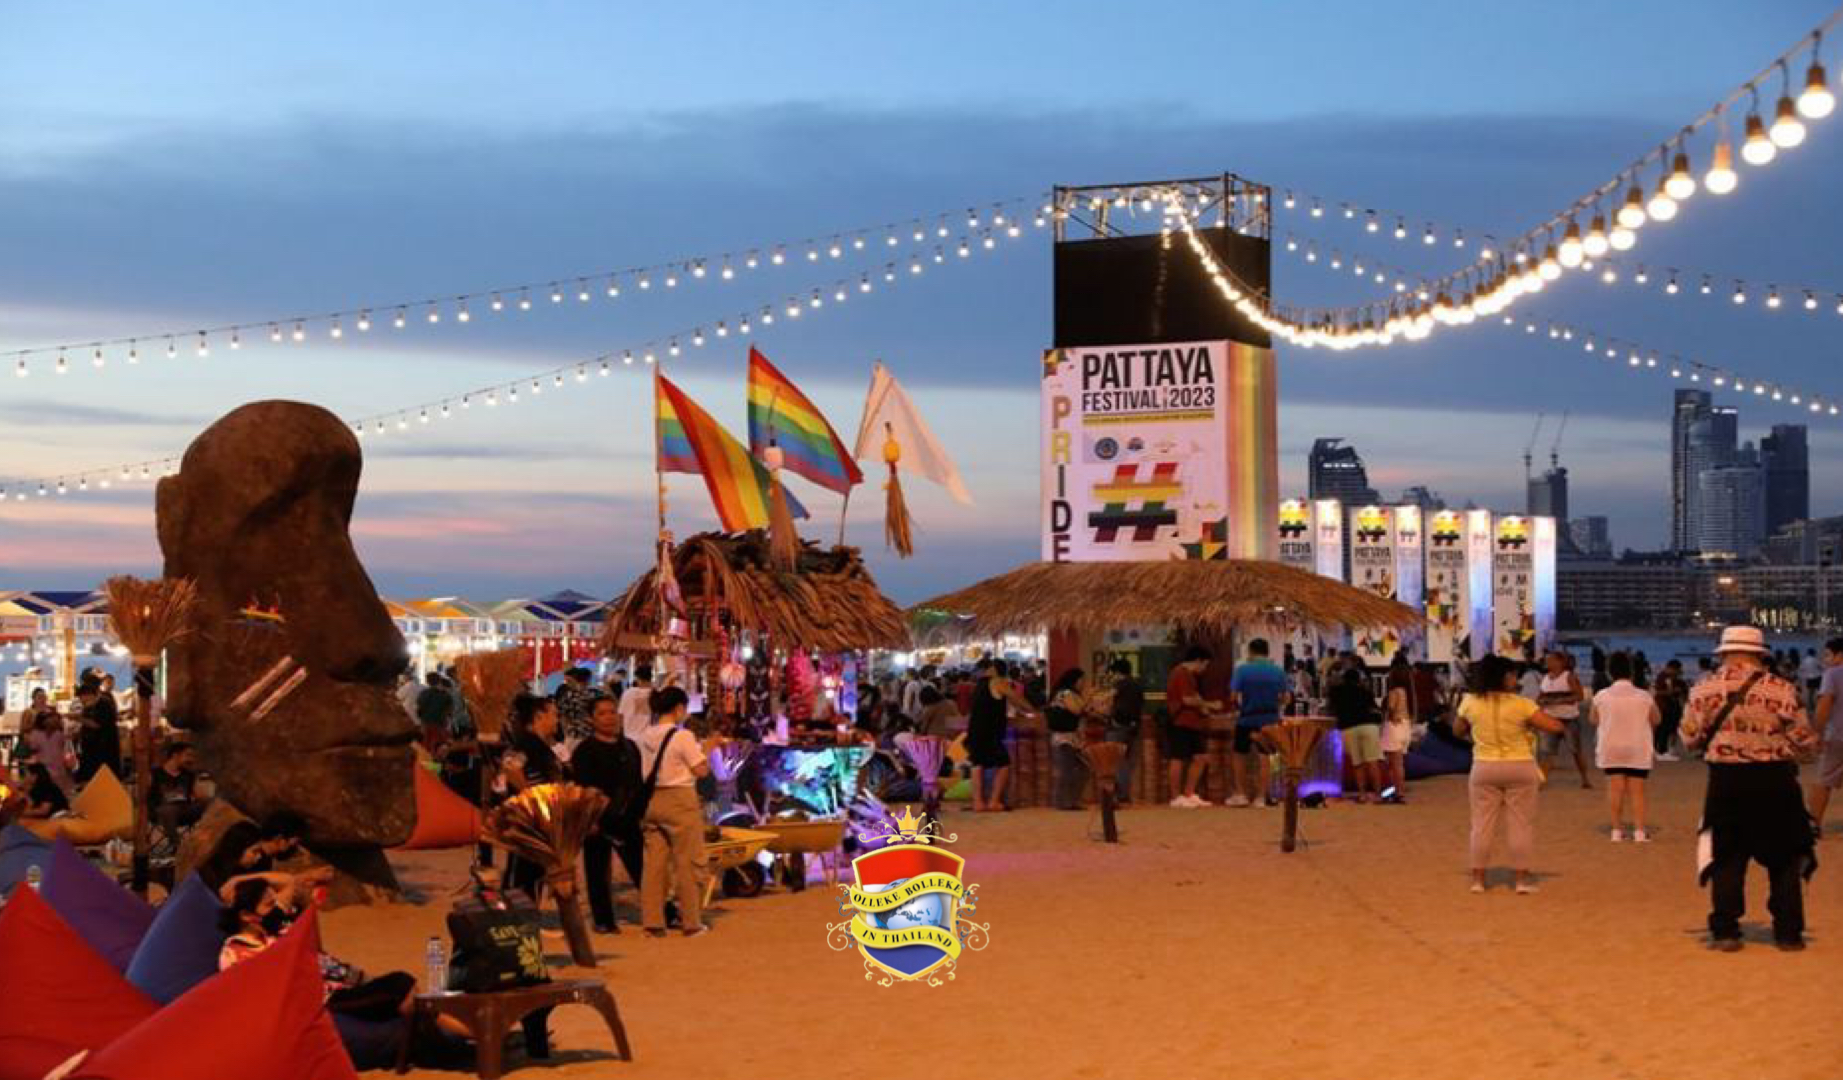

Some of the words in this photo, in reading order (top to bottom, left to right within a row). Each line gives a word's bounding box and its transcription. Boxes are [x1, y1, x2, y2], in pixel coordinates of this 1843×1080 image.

[1083, 347, 1214, 390] PATTAYA
[1083, 389, 1160, 411] FESTIVAL
[1170, 387, 1215, 407] 2023
[1051, 396, 1072, 562] PRIDE
